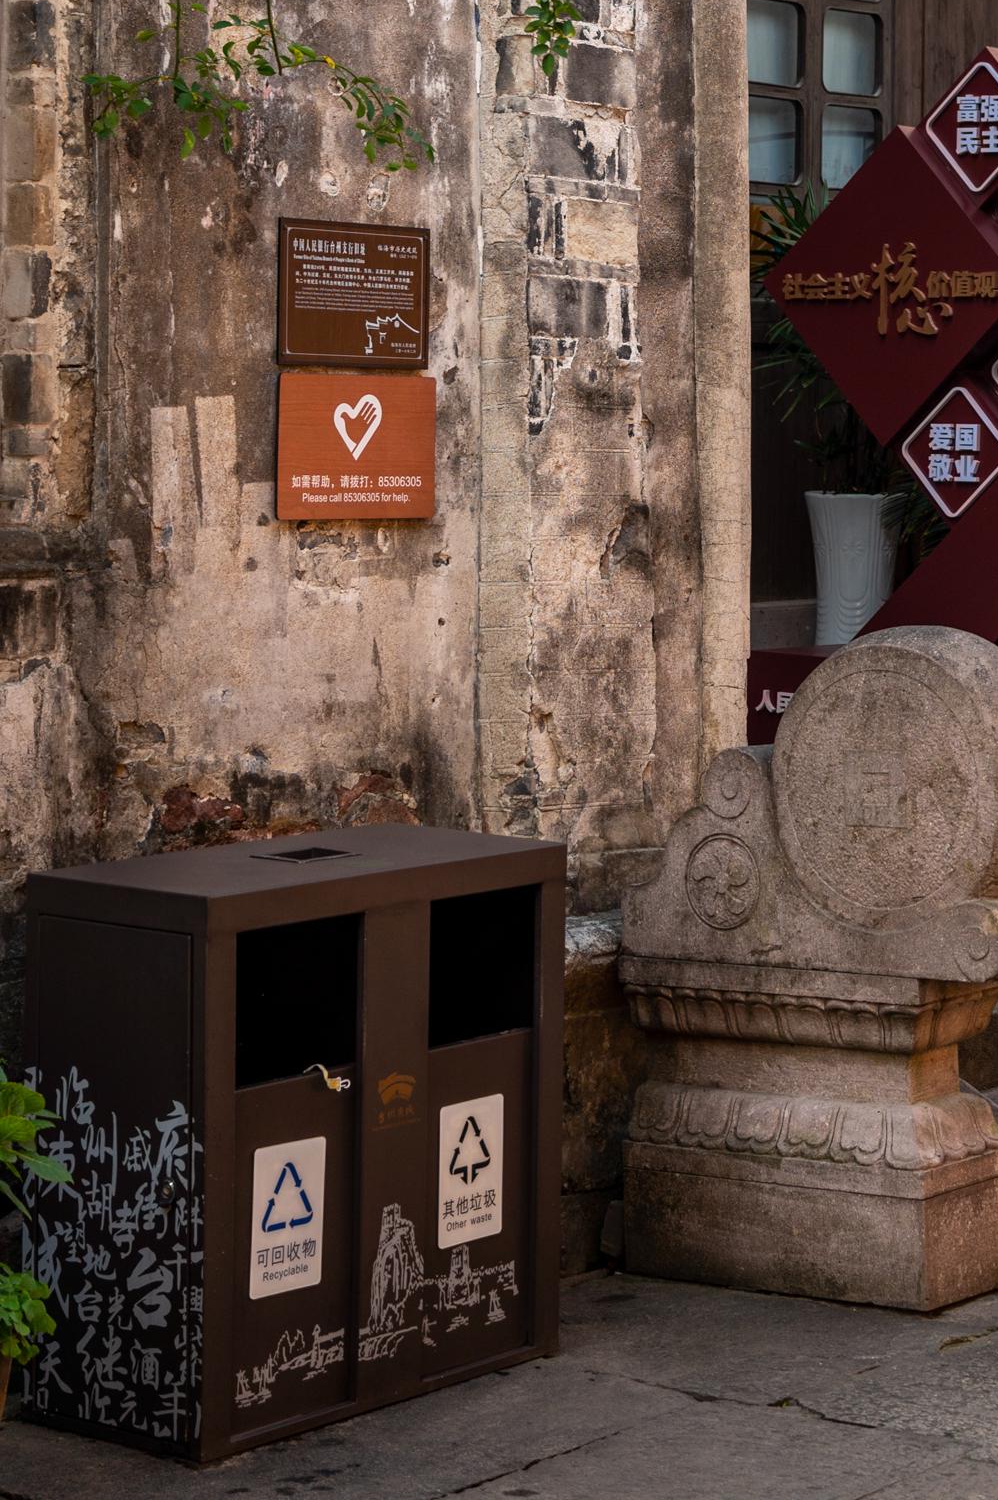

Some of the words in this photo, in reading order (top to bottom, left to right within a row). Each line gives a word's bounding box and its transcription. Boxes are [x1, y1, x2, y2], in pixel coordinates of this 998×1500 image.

[928, 423, 981, 451] 爱国
[928, 453, 981, 482] 敬业
[302, 492, 328, 503] Please
[329, 492, 342, 503] call
[343, 492, 380, 503] 85306305
[381, 492, 392, 503] for
[442, 1188, 497, 1220] 其他垃圾
[446, 1219, 467, 1233] Other
[470, 1213, 493, 1226] waste
[256, 1237, 317, 1268] 可回收物
[262, 1263, 309, 1282] Recyclable
